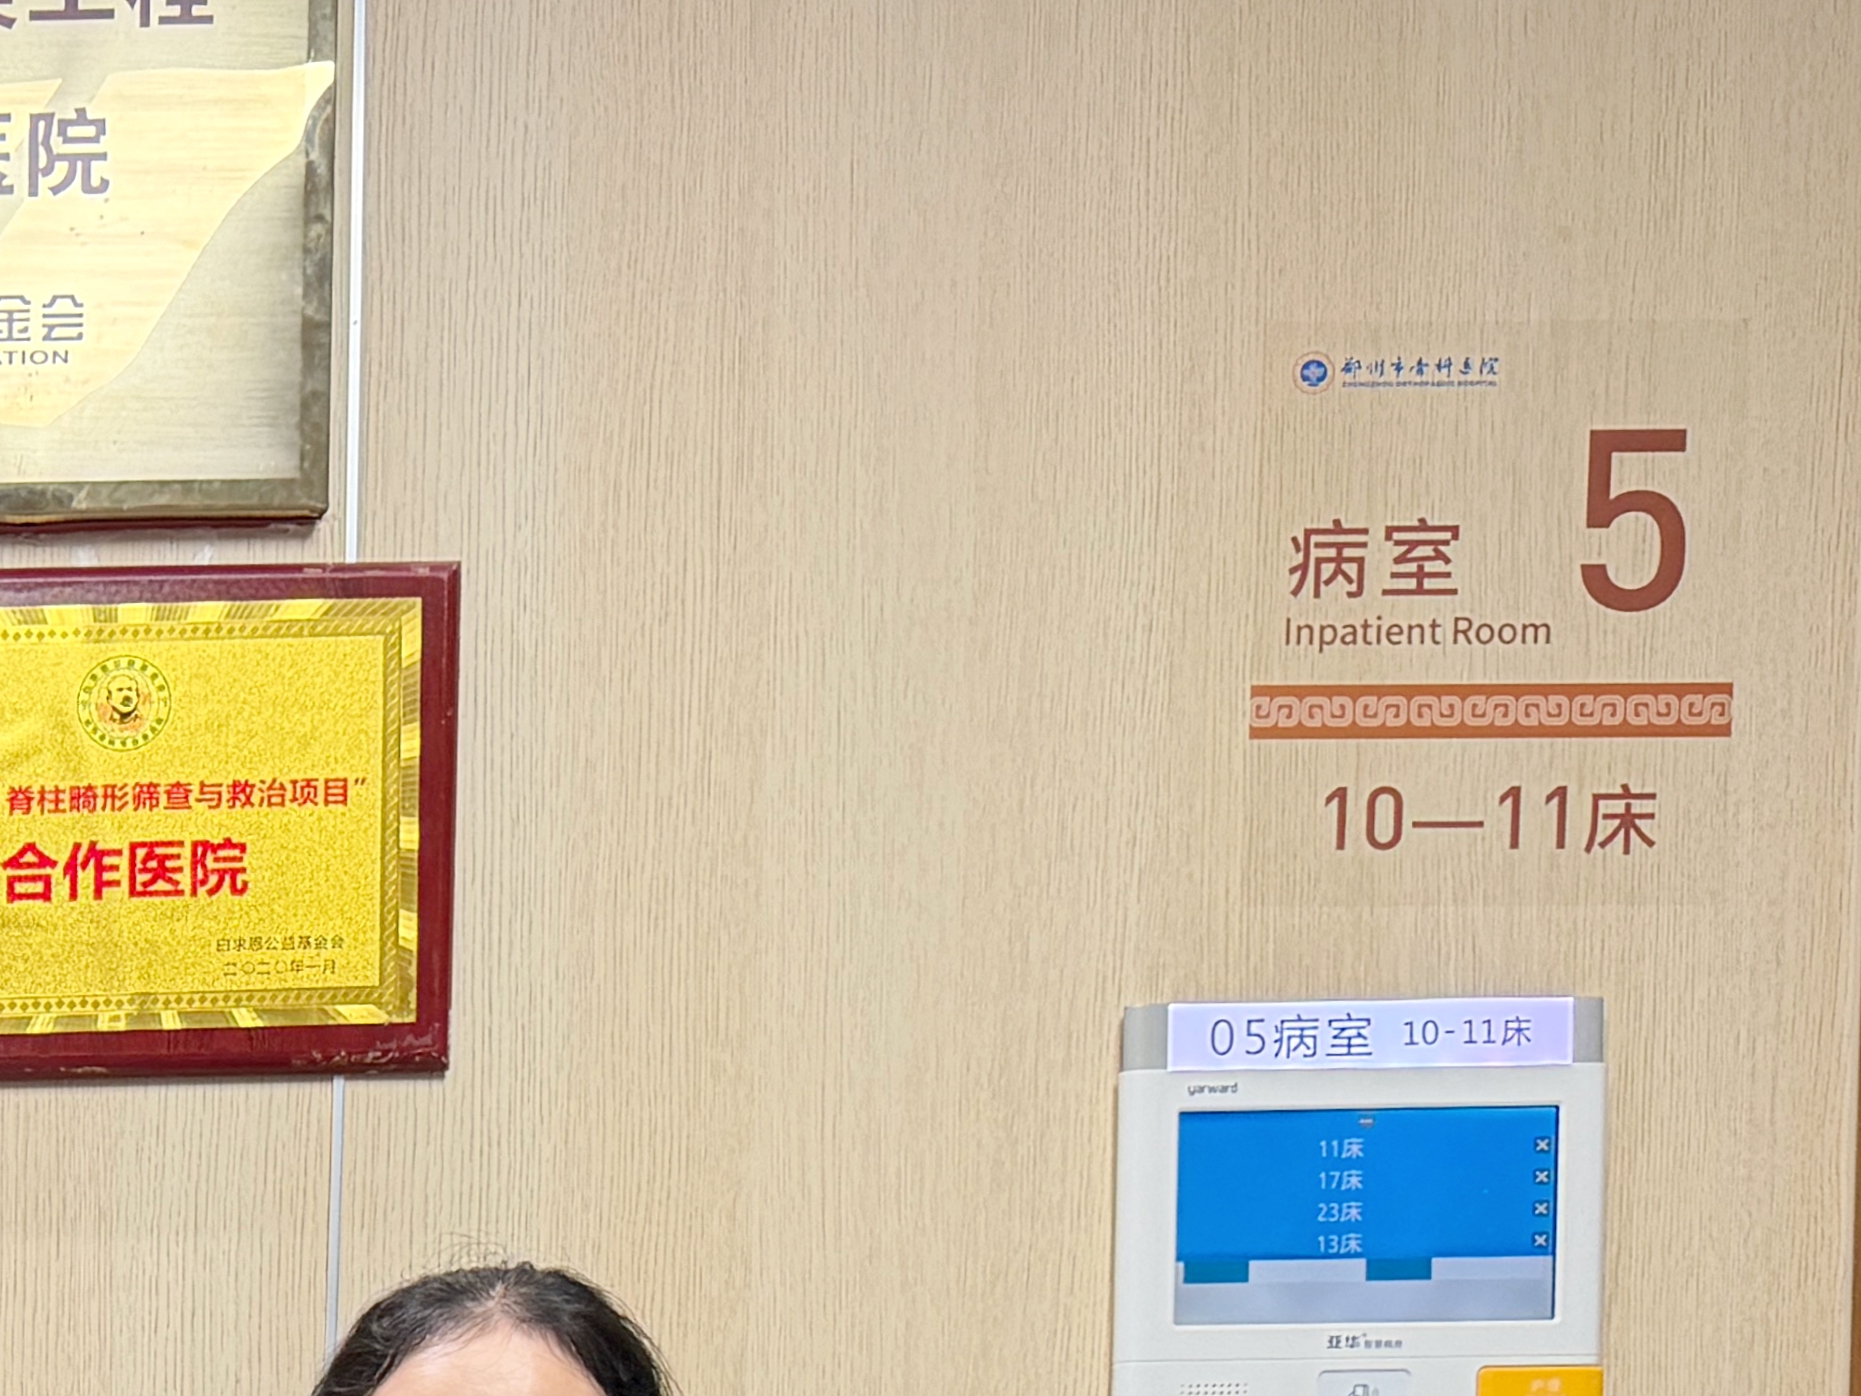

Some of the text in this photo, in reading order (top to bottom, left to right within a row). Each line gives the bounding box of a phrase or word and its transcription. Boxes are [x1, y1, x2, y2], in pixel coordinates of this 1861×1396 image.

[1580, 428, 1687, 613] 5
[1288, 517, 1461, 599] 病室
[1284, 616, 1552, 653] Inpatient Room
[0, 837, 248, 904] 合作医院
[1210, 1012, 1533, 1060] 05病室 10-11床
[1318, 1137, 1365, 1160] 11床
[1318, 1169, 1364, 1192] 17床
[1317, 1201, 1364, 1224] 23床
[1317, 1232, 1364, 1256] 13床
